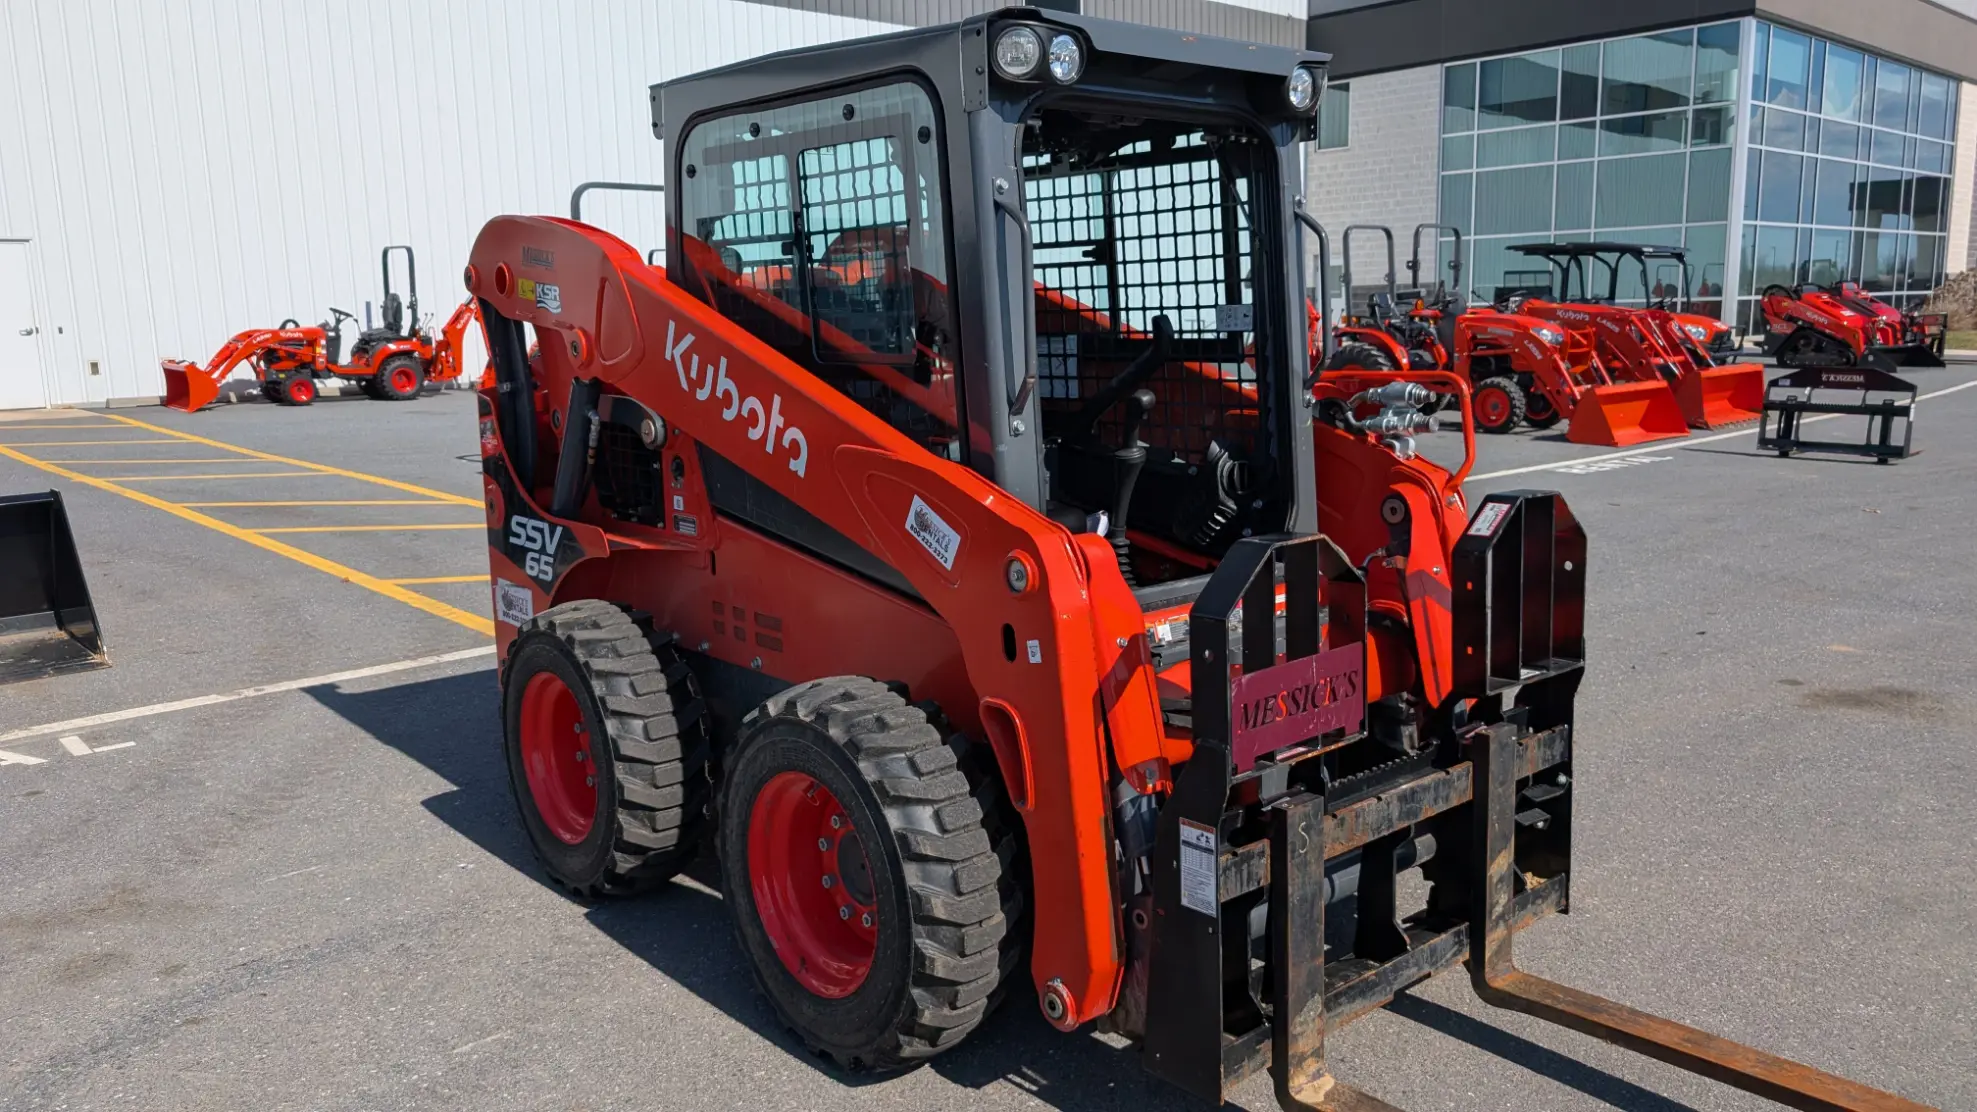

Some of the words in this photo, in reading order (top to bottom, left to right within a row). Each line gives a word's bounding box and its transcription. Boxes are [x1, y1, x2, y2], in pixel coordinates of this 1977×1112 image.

[536, 283, 560, 301] KSR
[1556, 309, 1590, 322] Kubota
[664, 319, 808, 479] Kubota
[509, 515, 563, 555] SSV
[525, 551, 554, 582] 65
[1241, 669, 1359, 730] MESSICK'S
